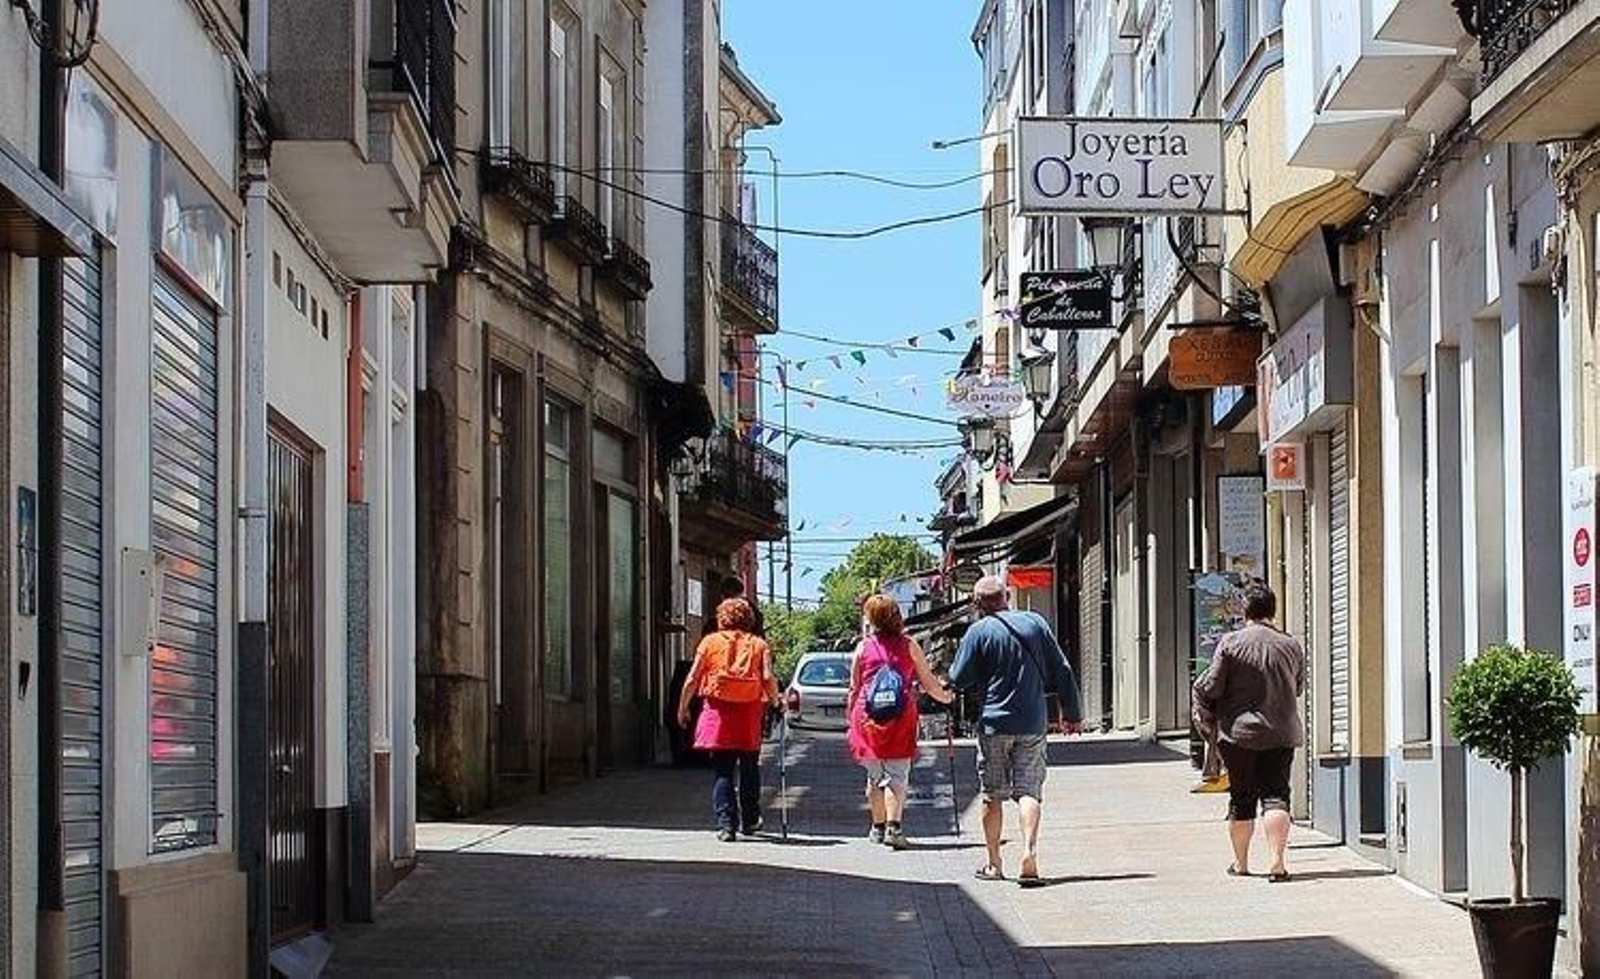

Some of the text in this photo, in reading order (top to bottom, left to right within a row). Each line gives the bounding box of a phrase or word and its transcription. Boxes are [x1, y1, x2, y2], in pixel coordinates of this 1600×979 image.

[1064, 122, 1188, 161] Joyería
[1033, 157, 1214, 208] Oro Ley
[1055, 293, 1073, 306] de
[1027, 306, 1102, 323] Caballeros
